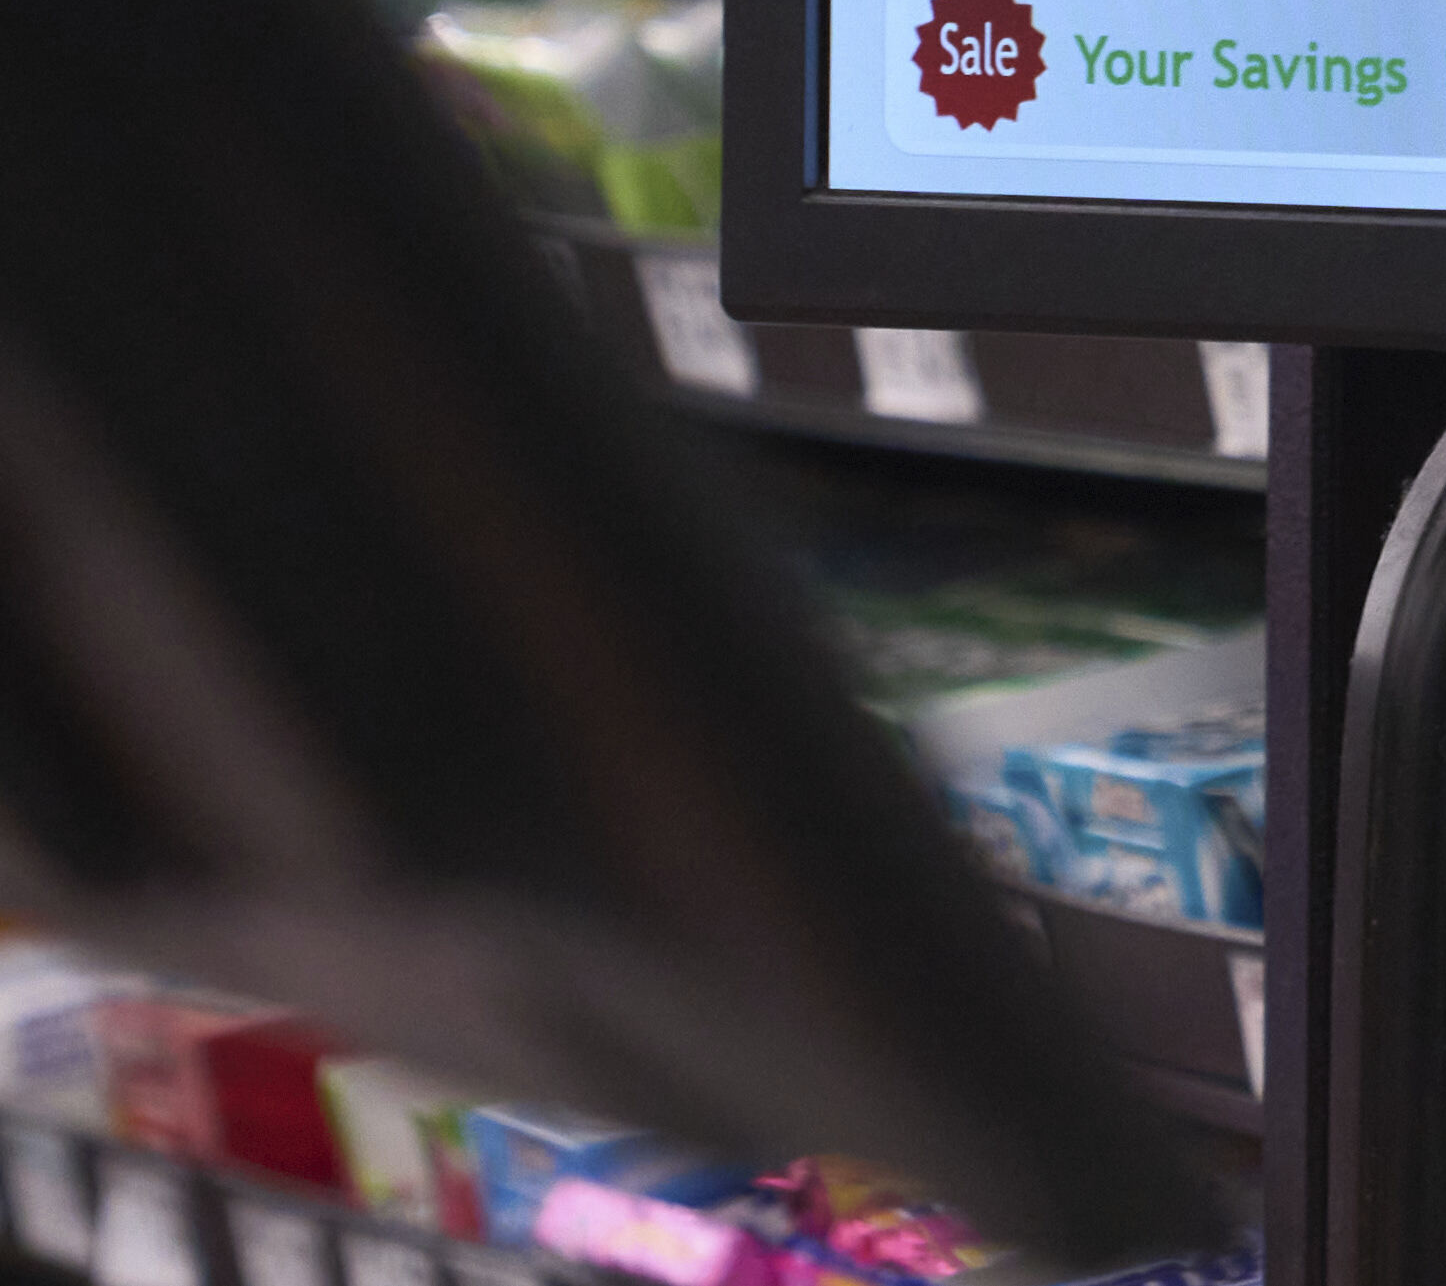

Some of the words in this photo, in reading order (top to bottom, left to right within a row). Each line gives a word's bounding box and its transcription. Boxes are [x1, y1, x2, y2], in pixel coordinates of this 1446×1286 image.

[940, 22, 1018, 76] Sale
[1075, 35, 1193, 87] Your
[1213, 39, 1408, 107] Savings
